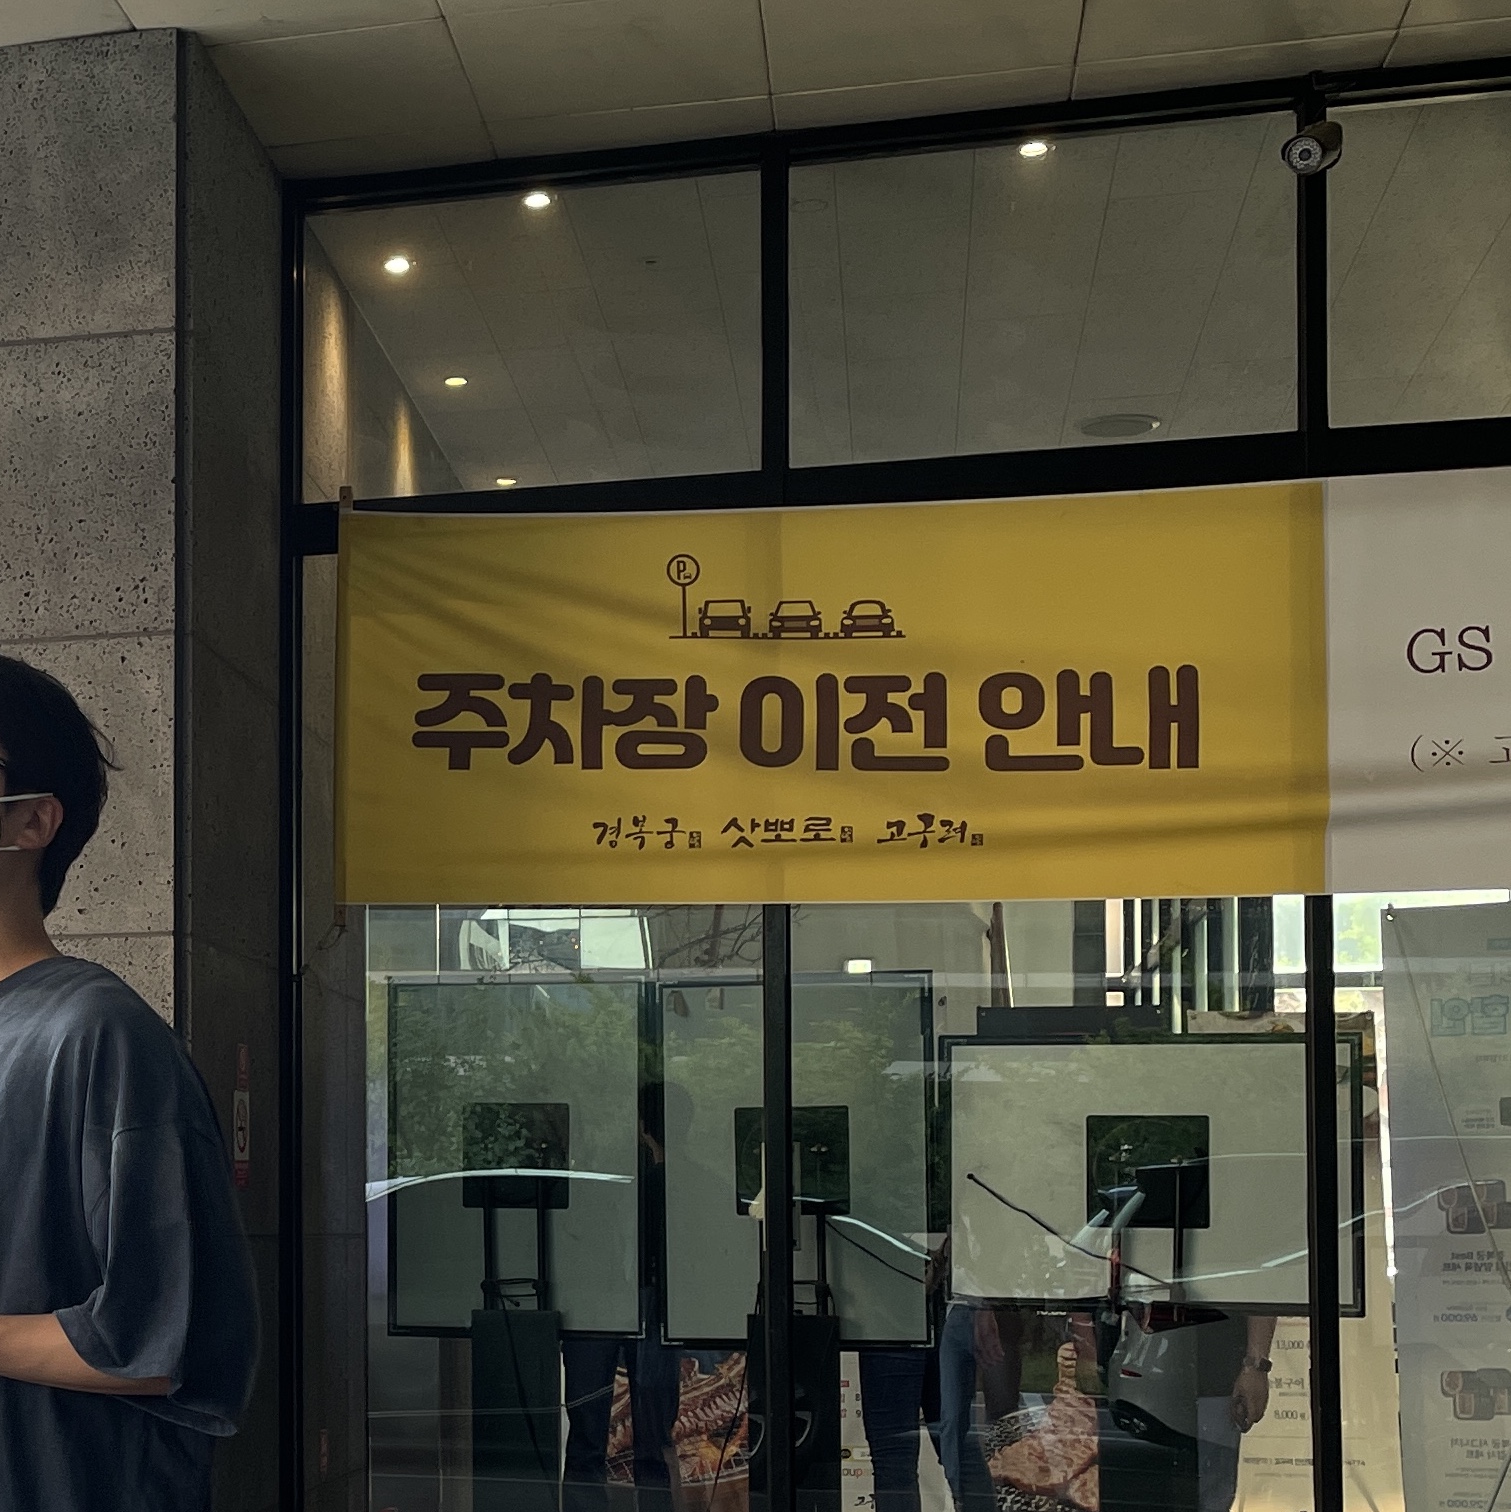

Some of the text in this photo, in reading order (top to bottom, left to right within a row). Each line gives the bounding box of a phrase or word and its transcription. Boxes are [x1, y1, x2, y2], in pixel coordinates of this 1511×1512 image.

[1406, 625, 1493, 674] GS
[412, 664, 1200, 772] 주차장 이전 안내
[592, 814, 687, 850] 경복궁
[721, 815, 836, 849] 삿뽀로
[876, 813, 968, 849] 고구려
